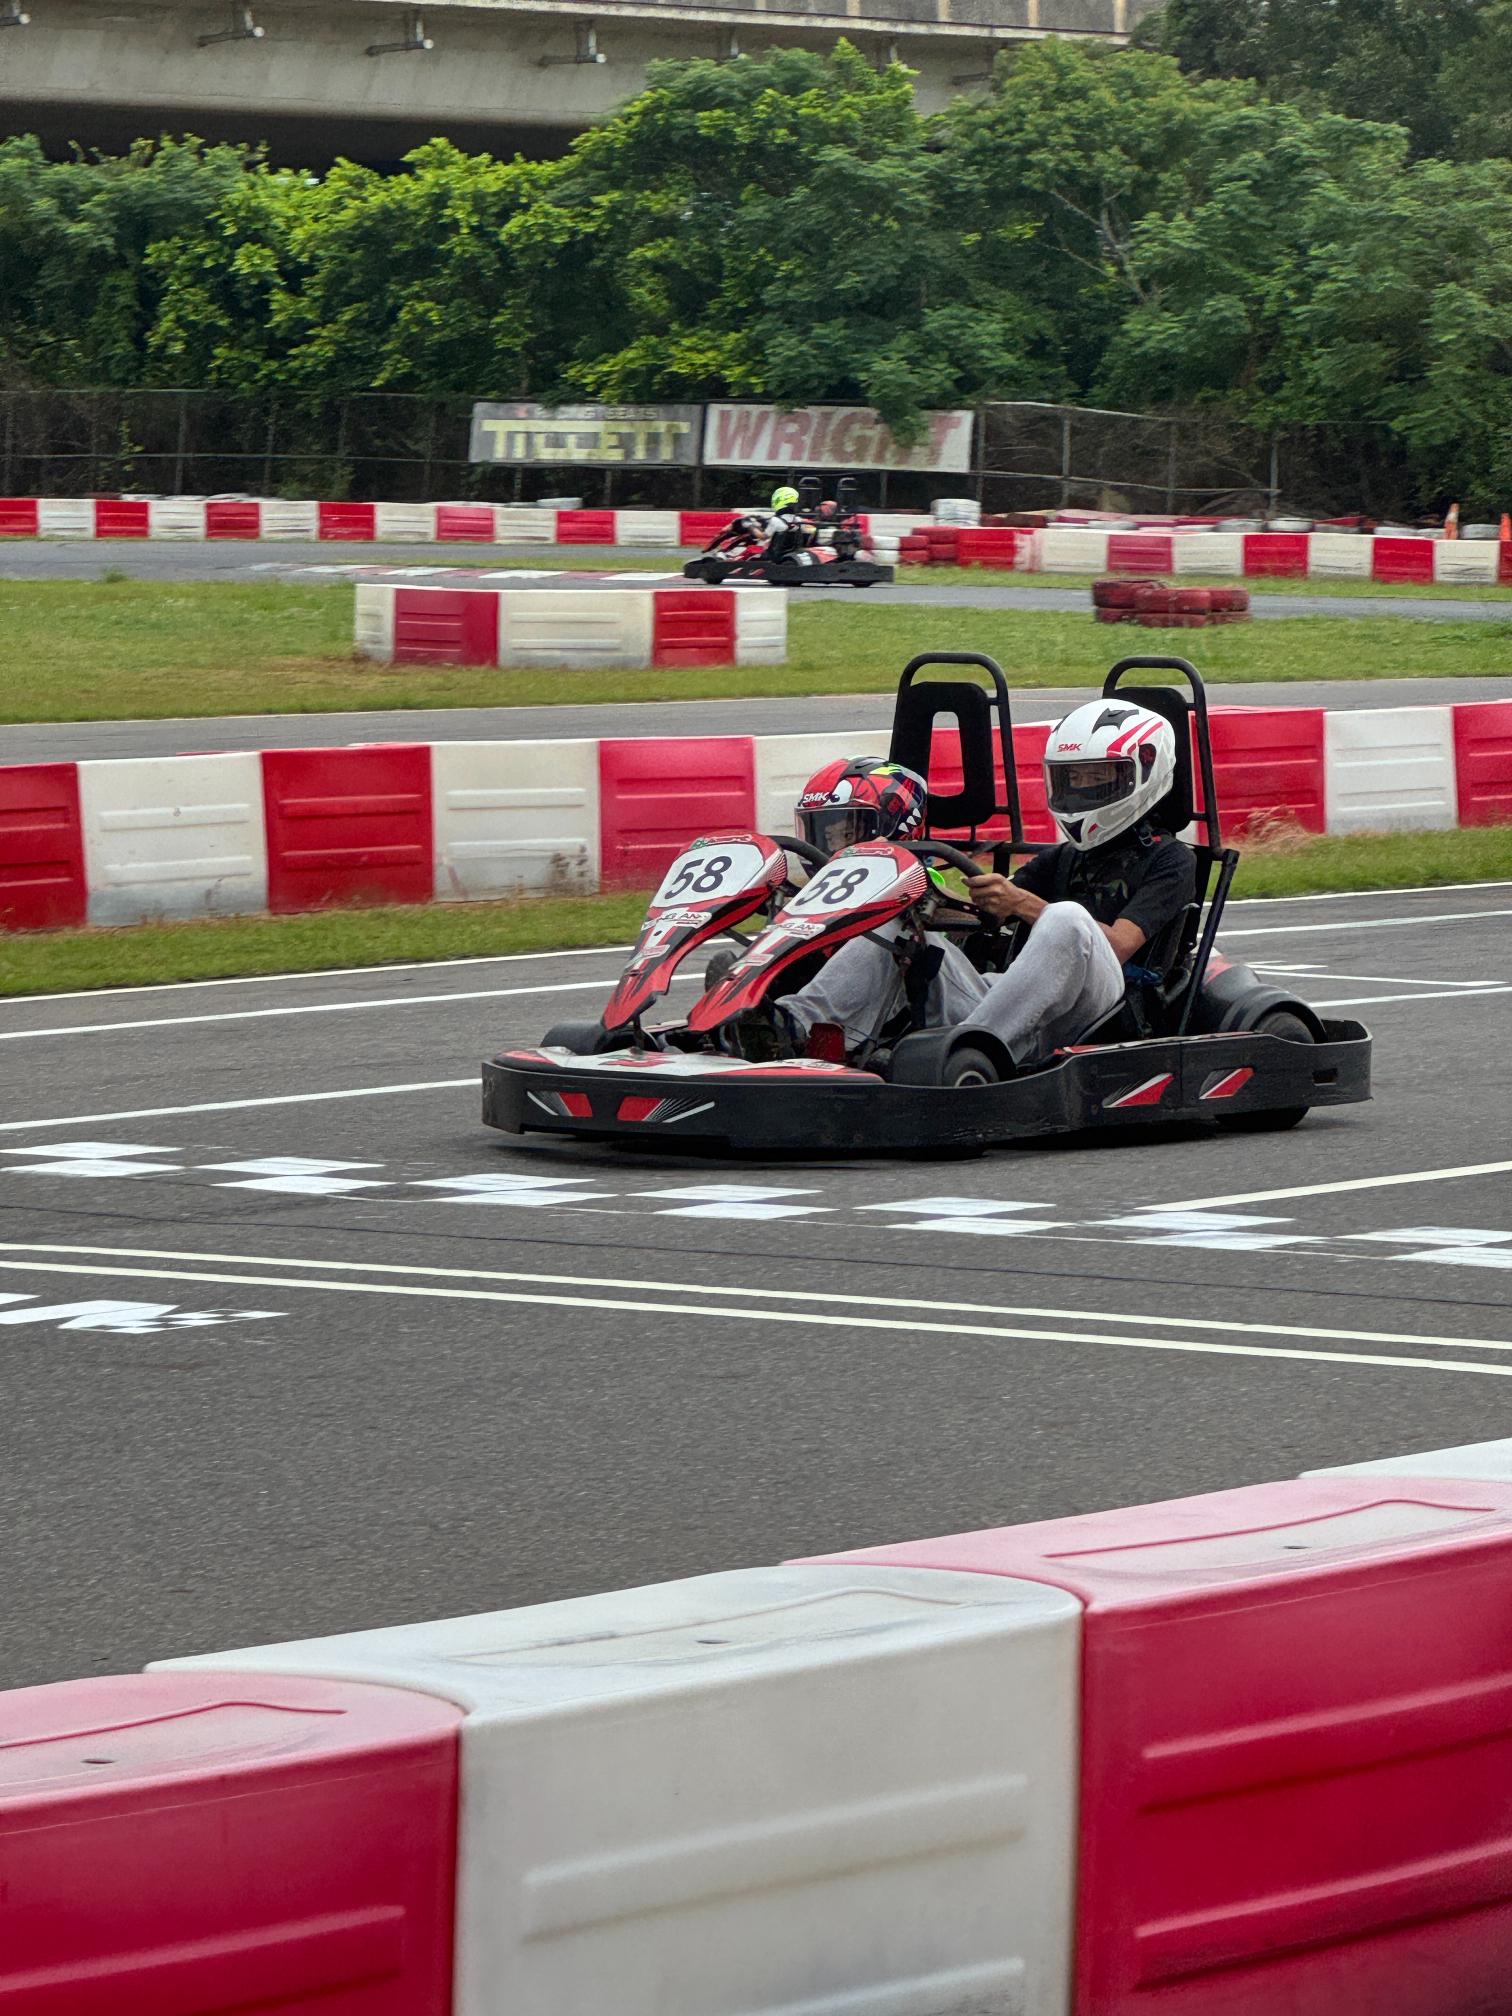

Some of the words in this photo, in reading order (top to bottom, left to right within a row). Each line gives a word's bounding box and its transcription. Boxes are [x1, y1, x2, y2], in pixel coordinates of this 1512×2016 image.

[482, 419, 691, 461] TILLETT
[1057, 742, 1083, 753] SMK
[802, 791, 831, 804] SMK
[664, 855, 733, 899] 58
[794, 867, 870, 907] 58
